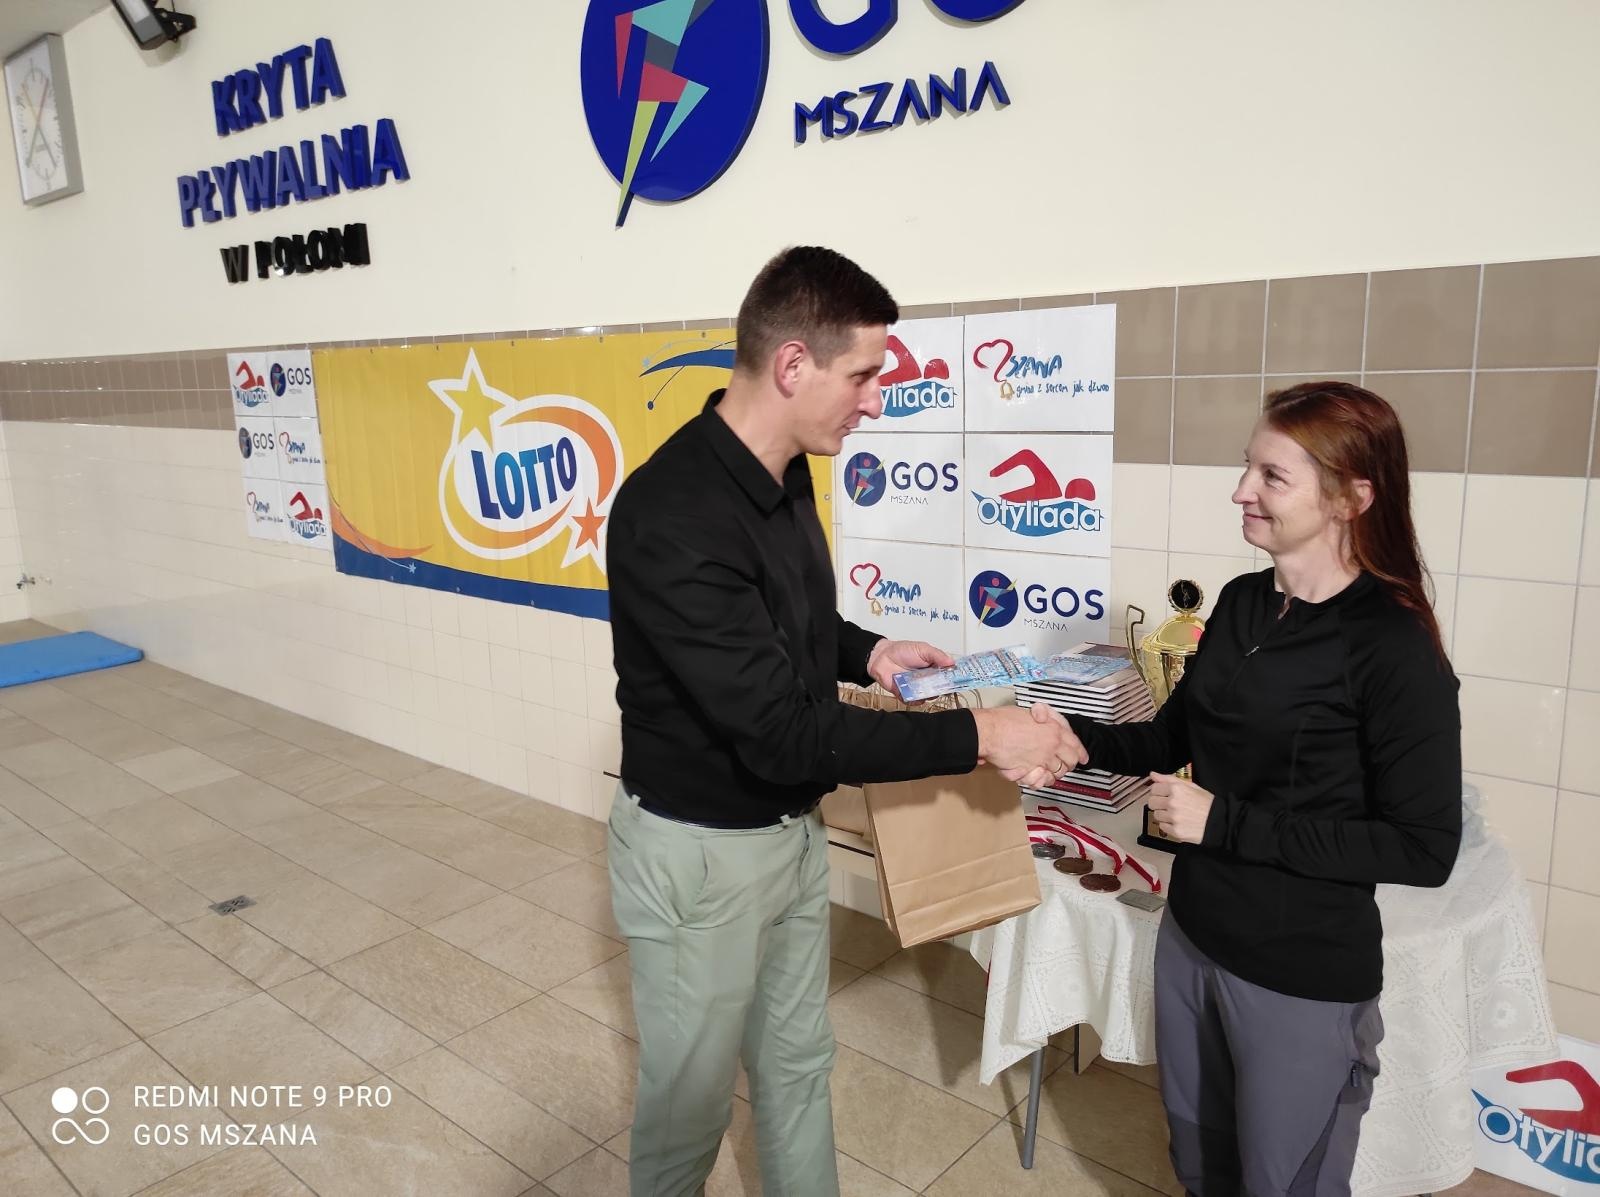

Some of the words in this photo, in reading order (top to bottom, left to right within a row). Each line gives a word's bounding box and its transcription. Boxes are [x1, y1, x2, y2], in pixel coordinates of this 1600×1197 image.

[211, 37, 347, 137] KRYTA
[794, 60, 1011, 145] MSZANA
[177, 118, 410, 228] PŁYWALNIA
[220, 244, 249, 283] W
[287, 367, 312, 386] GOS
[1072, 379, 1084, 398] jak
[879, 382, 955, 416] yliada
[252, 433, 275, 450] GOS
[470, 436, 578, 521] LOTTO
[890, 461, 959, 493] GOS
[890, 495, 929, 506] MSZANA
[977, 497, 1101, 533] Otyliada
[1023, 583, 1104, 621] GOS
[1023, 618, 1069, 633] MSZANA
